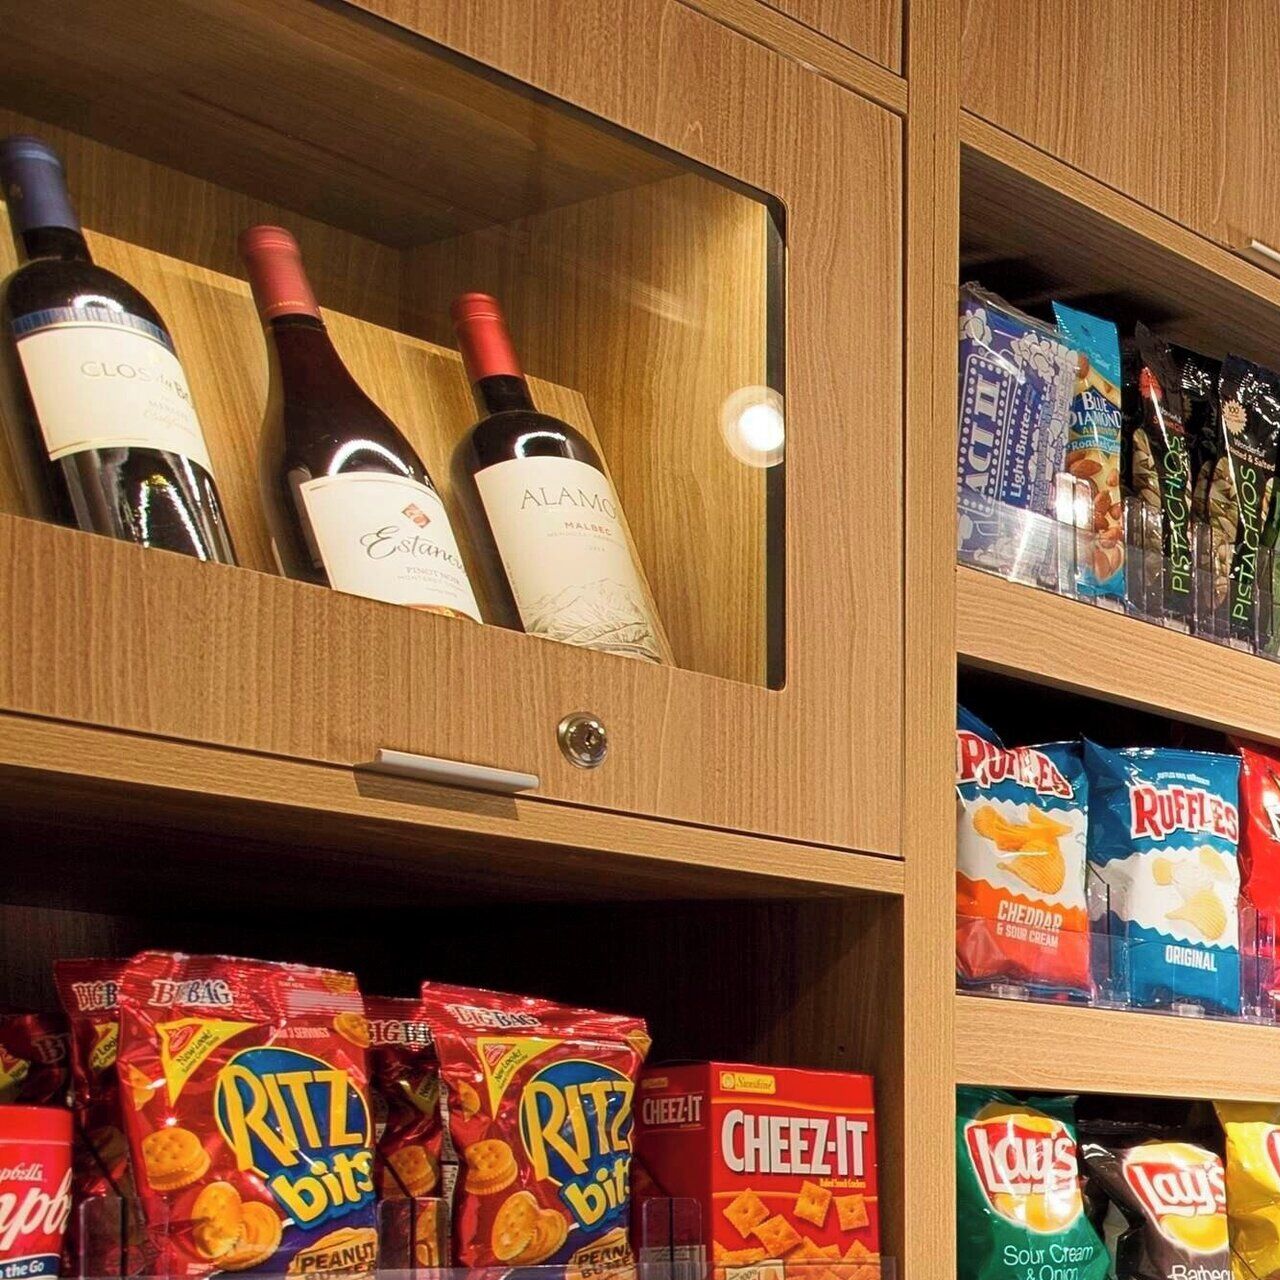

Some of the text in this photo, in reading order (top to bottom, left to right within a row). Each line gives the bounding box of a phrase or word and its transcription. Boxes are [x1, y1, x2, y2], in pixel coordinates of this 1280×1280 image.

[1081, 390, 1109, 413] BLUE
[964, 423, 995, 495] ACT
[1009, 404, 1033, 498] Light Butter
[564, 521, 612, 537] MALBEC
[1159, 435, 1192, 595] PISTACHIOS
[1232, 467, 1259, 621] PISTACHIOS
[1133, 788, 1239, 843] RUFFLES
[996, 899, 1063, 932] CHEDDAR
[1004, 924, 1028, 942] SOUR
[1028, 929, 1059, 948] CREAM
[1165, 945, 1218, 972] ORIGINAL
[217, 1063, 365, 1172] RITZ
[523, 1080, 635, 1182] RITZ
[642, 1095, 703, 1126] CHEEZ-IT
[721, 1108, 869, 1178] CHEEZ-IT
[271, 1151, 376, 1223] bits
[1133, 1161, 1227, 1218] Lay's
[5, 1261, 45, 1279] the Go
[299, 1242, 377, 1272] PEANUT
[1003, 1243, 1094, 1267] Sour Cream
